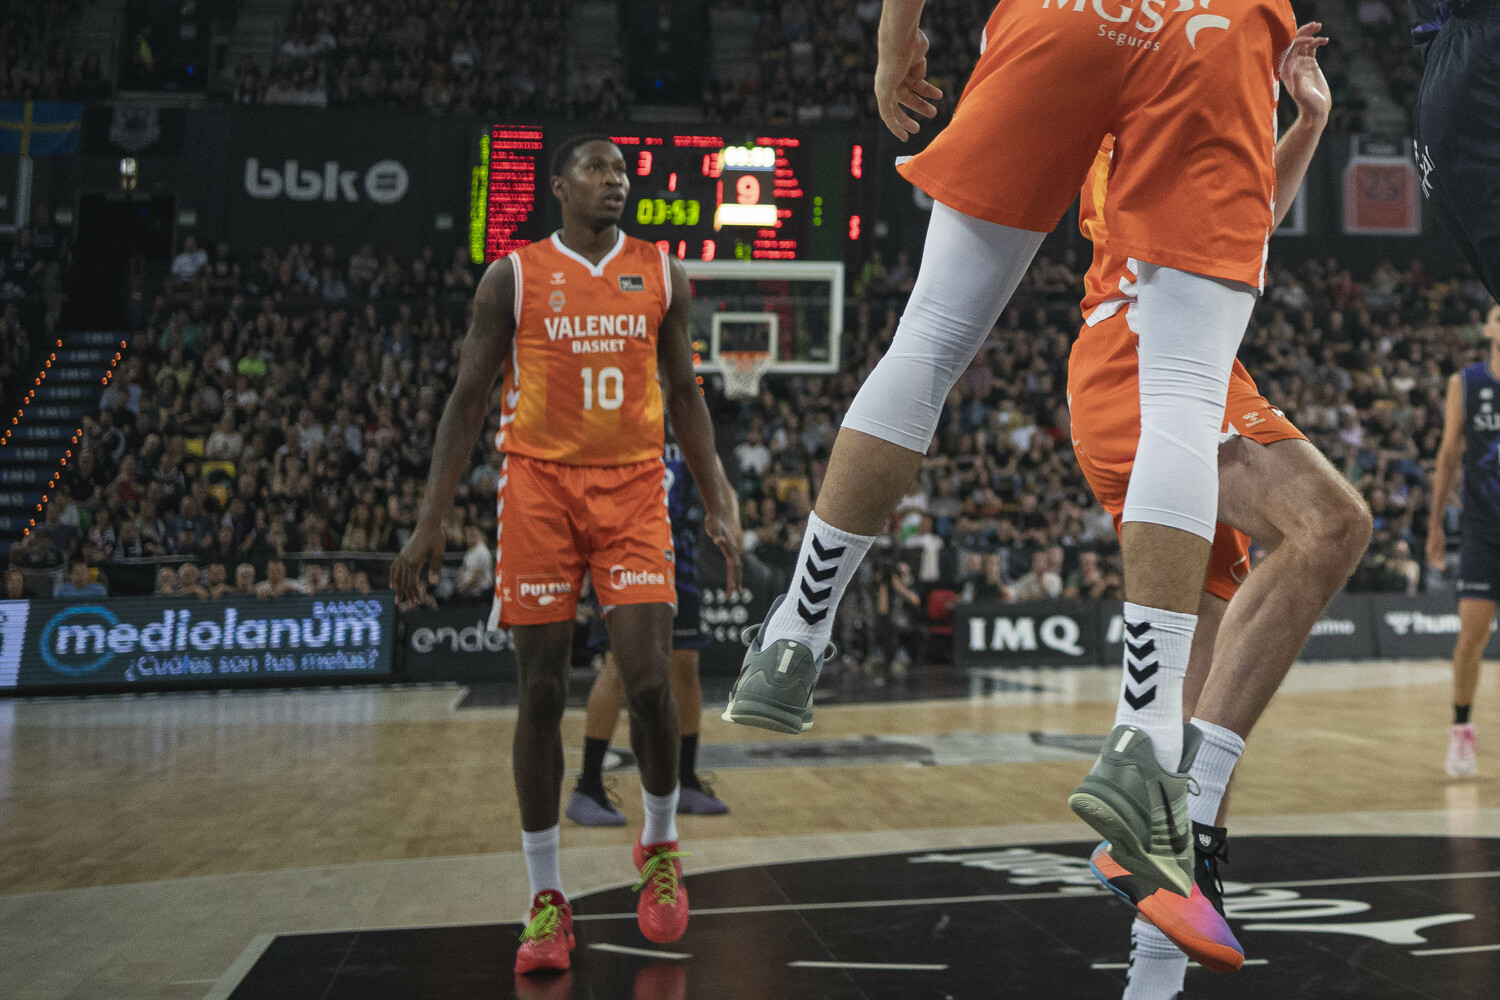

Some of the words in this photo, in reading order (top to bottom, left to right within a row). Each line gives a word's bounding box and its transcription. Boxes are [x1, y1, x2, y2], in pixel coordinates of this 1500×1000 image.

[1097, 24, 1161, 51] Seguros
[245, 157, 359, 200] bbk
[736, 174, 761, 205] 9
[544, 314, 647, 341] VALENCIA
[571, 339, 626, 354] BASKET
[580, 366, 625, 411] 10
[55, 607, 382, 656] mediolanum
[968, 614, 1086, 656] IMQ
